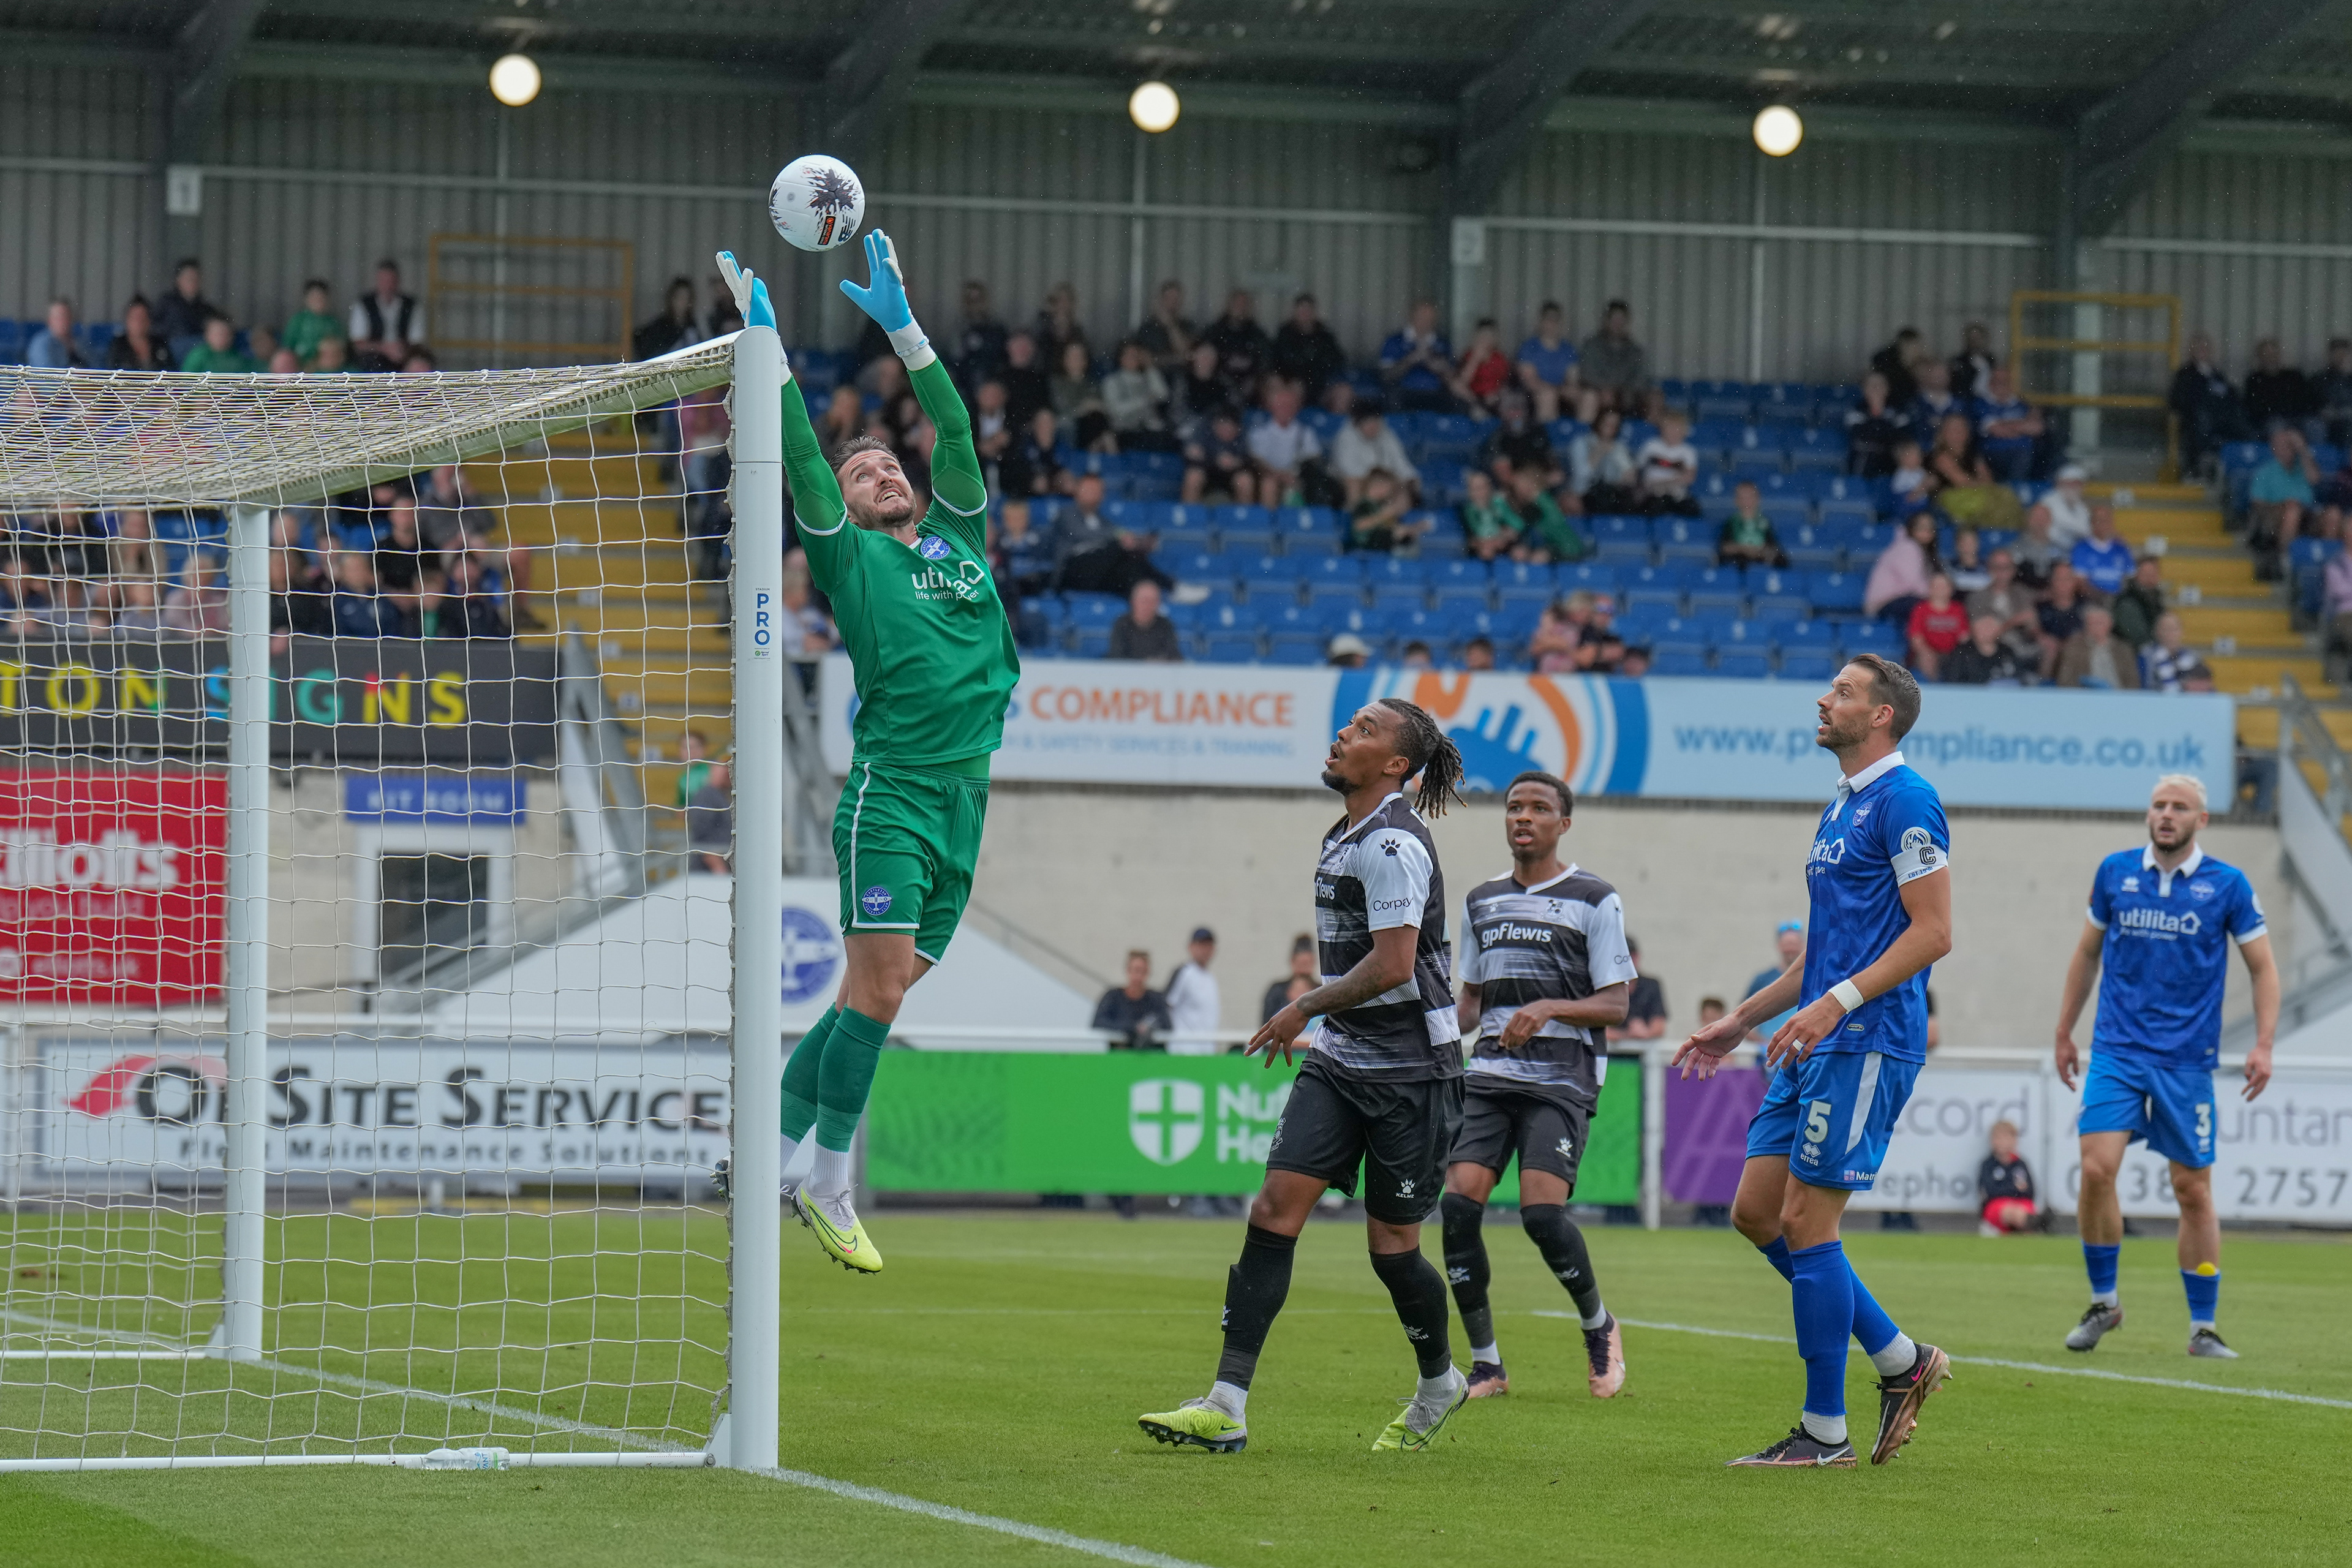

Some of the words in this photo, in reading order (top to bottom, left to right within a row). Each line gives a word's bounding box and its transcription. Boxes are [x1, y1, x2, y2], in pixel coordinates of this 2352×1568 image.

[915, 591, 929, 600] life
[932, 590, 953, 600] with
[754, 593, 771, 646] PRO
[1030, 685, 1294, 727] COMPLIANCE
[1919, 846, 1937, 865] C
[1314, 876, 1335, 900] flewis
[1373, 897, 1412, 911] Corpay
[2119, 908, 2180, 932] utilita
[1482, 922, 1553, 949] gpflewis
[1804, 1100, 1832, 1144] 5
[2194, 1103, 2212, 1138] 3
[1800, 1153, 1819, 1167] errea
[2236, 1167, 2348, 1207] 2757
